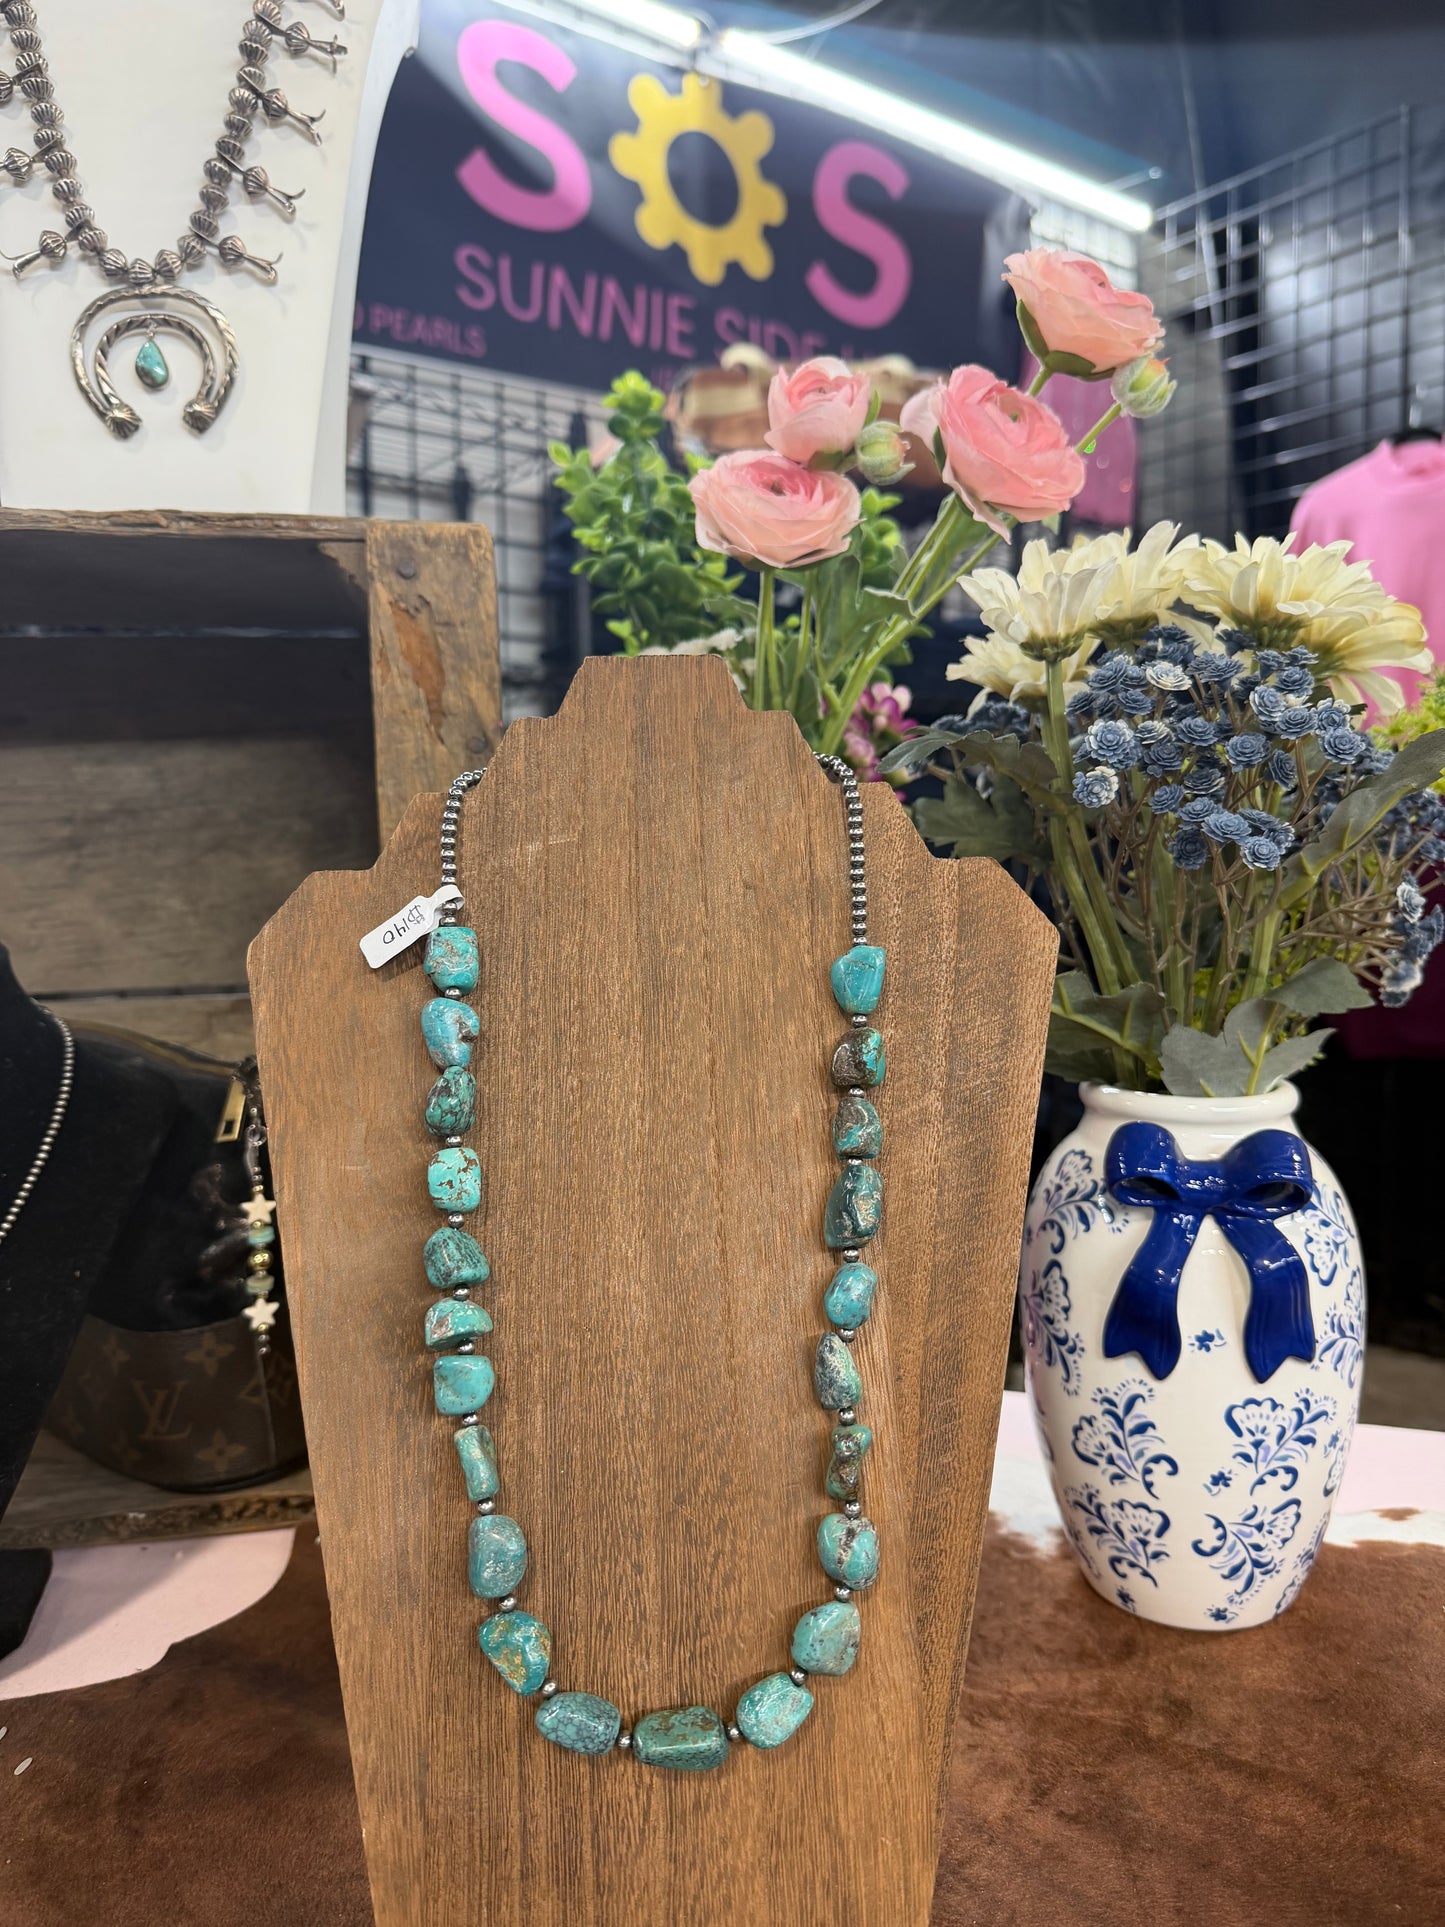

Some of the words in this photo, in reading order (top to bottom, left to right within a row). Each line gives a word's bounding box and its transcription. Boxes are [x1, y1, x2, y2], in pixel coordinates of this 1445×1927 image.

[454, 243, 698, 359] SUNNIE
[369, 302, 487, 359] PEARLS
[382, 904, 425, 945] $140
